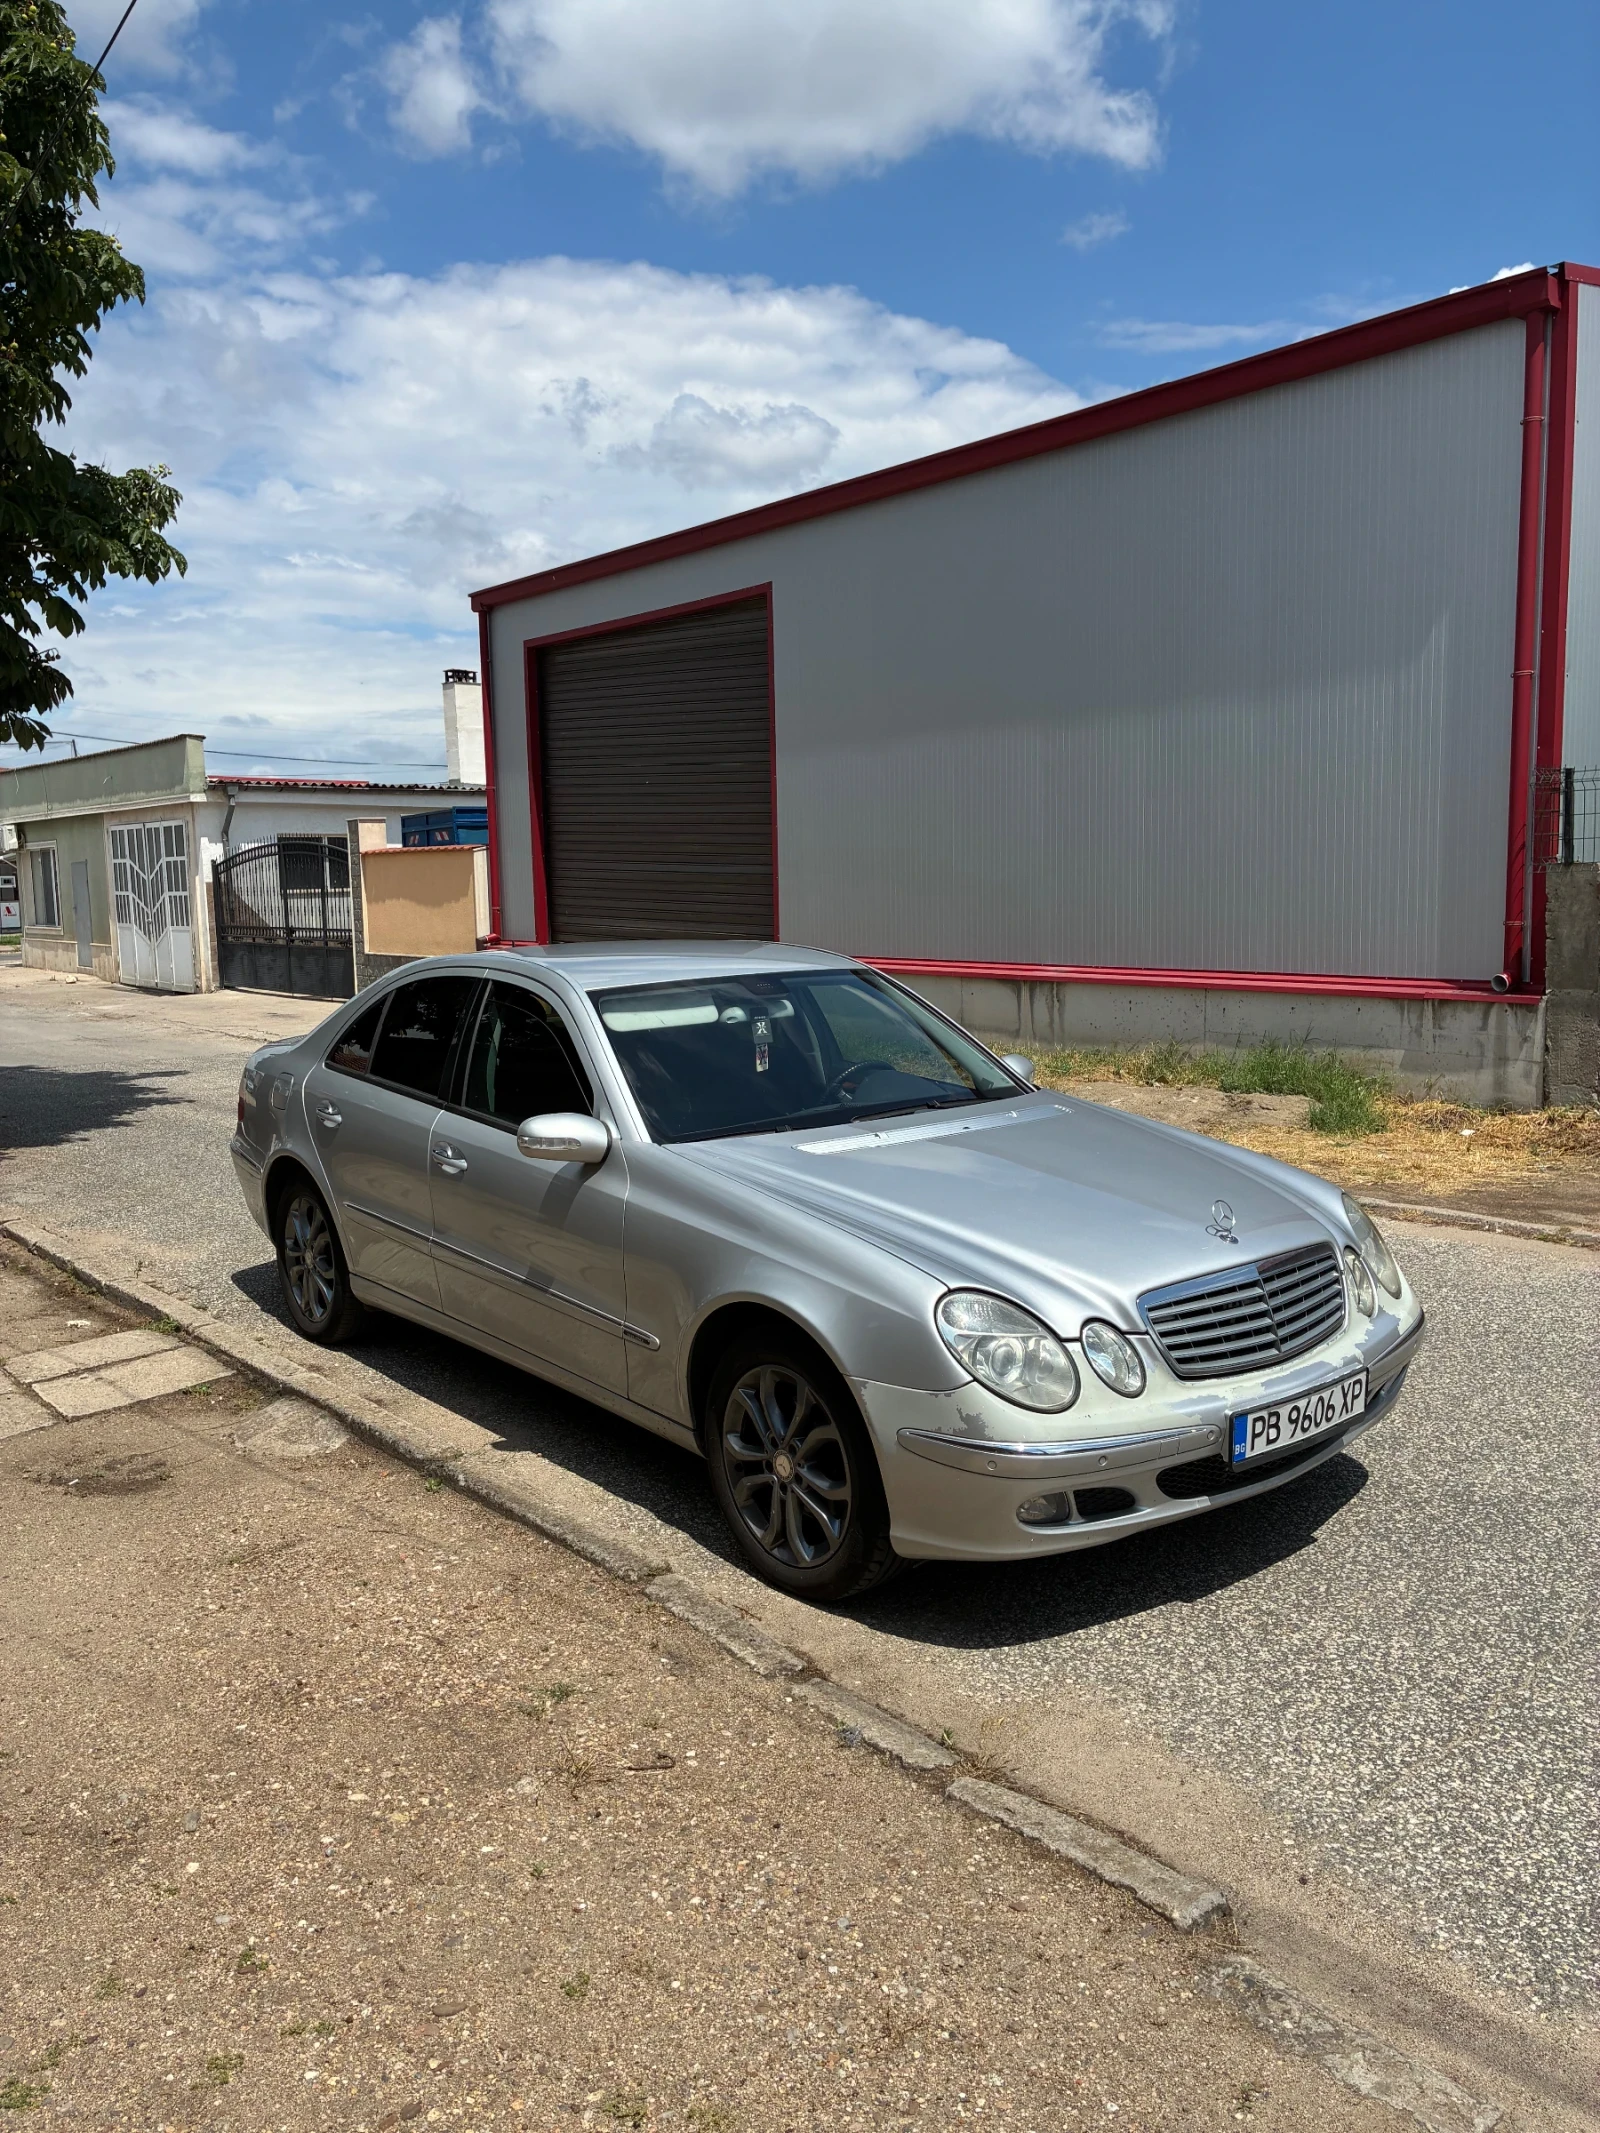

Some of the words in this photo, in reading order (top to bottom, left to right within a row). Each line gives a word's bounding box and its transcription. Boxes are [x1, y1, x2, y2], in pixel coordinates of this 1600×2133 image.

[1251, 1411, 1281, 1451] PB
[1288, 1390, 1336, 1439] 9606
[1339, 1378, 1363, 1418] XP
[1234, 1443, 1246, 1455] BG
